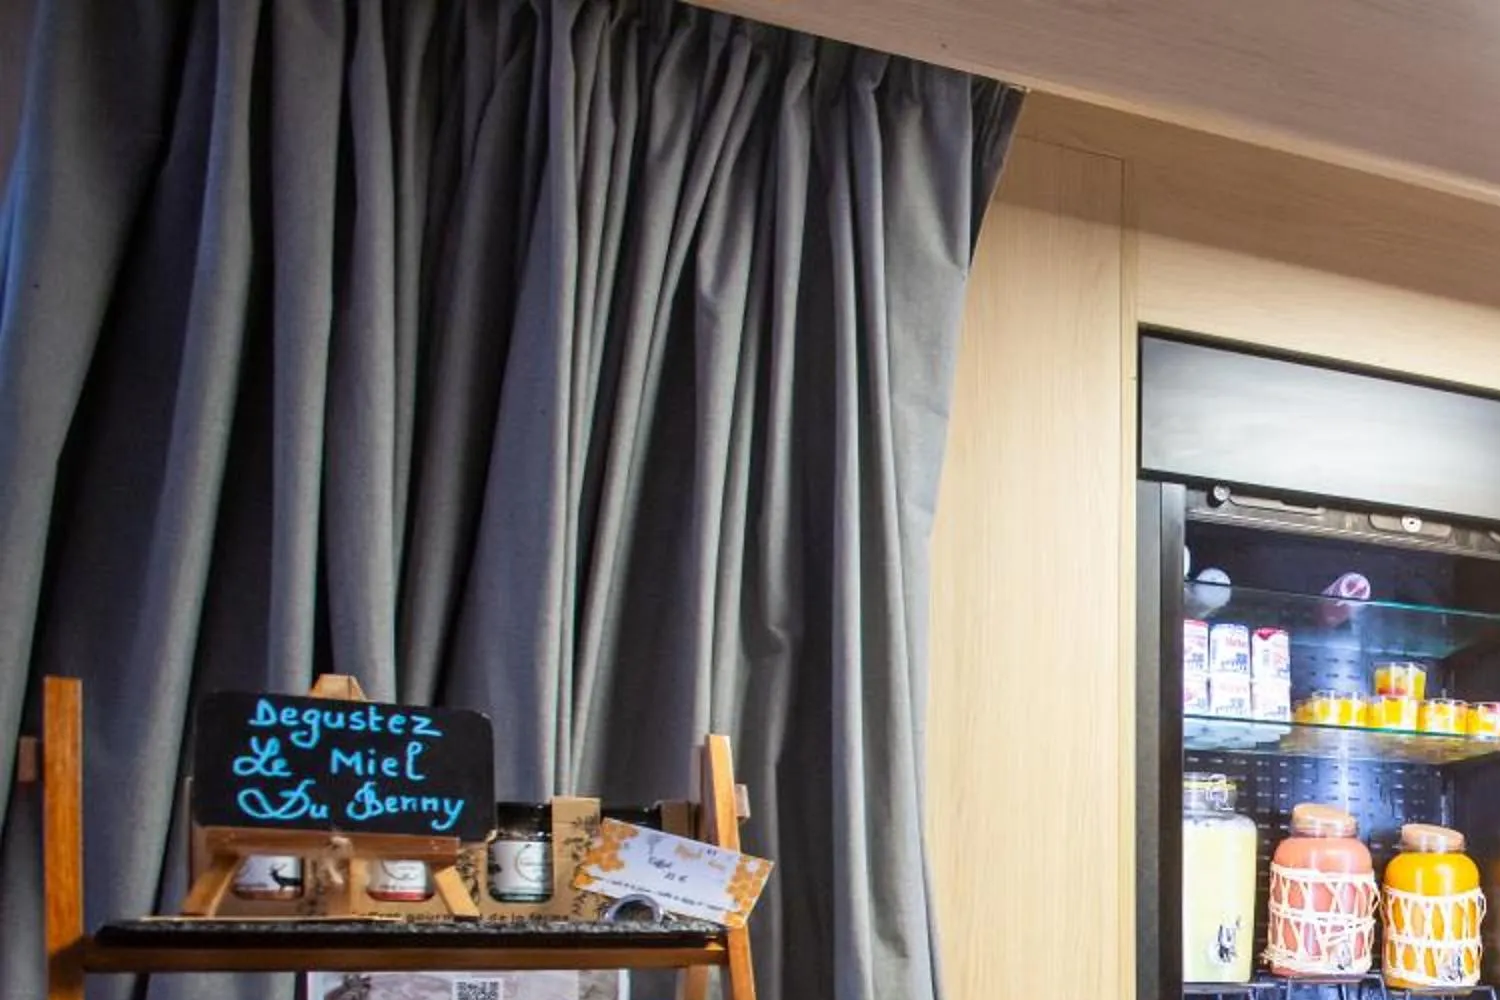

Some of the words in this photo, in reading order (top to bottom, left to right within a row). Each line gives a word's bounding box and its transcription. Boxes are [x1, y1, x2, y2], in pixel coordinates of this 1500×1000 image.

[247, 698, 442, 749] Degustez
[232, 735, 292, 777] Le
[330, 741, 426, 780] Miel
[237, 779, 328, 818] Du
